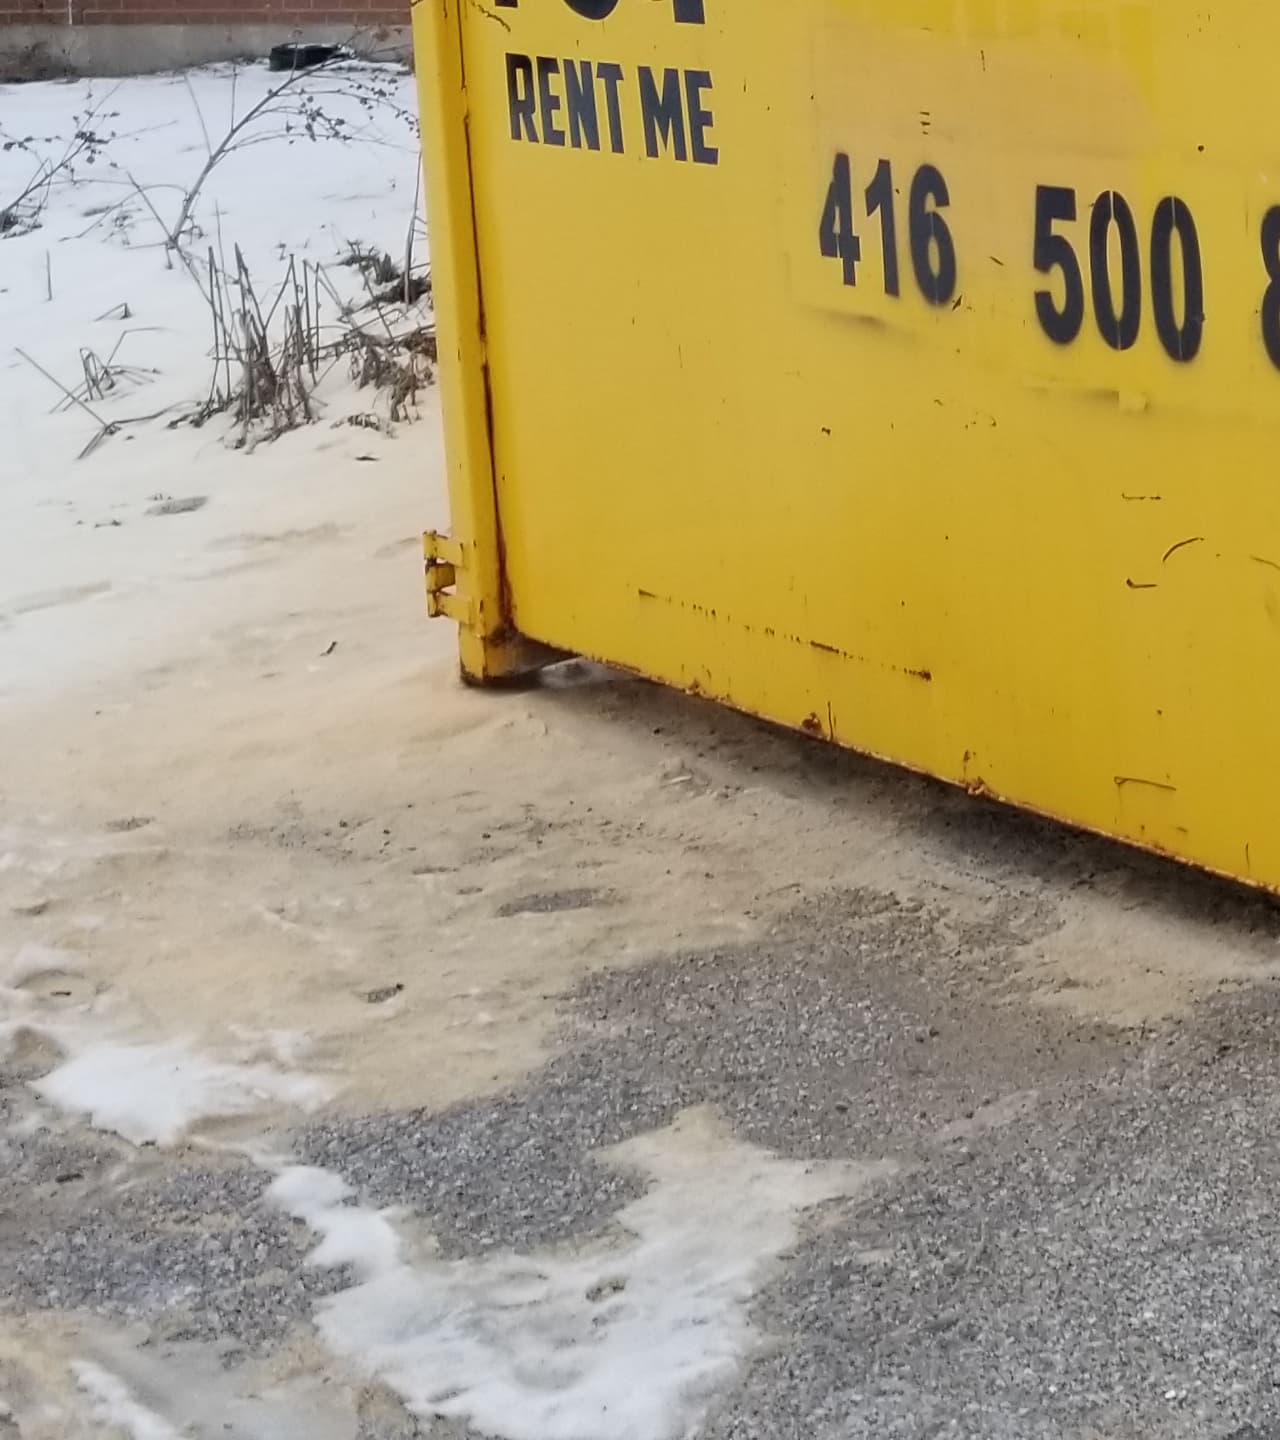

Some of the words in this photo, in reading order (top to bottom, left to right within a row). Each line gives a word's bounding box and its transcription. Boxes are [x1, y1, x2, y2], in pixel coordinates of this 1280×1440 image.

[505, 52, 624, 154] RENT
[637, 65, 720, 166] ME
[818, 152, 958, 306] 416
[1032, 183, 1204, 362] 500
